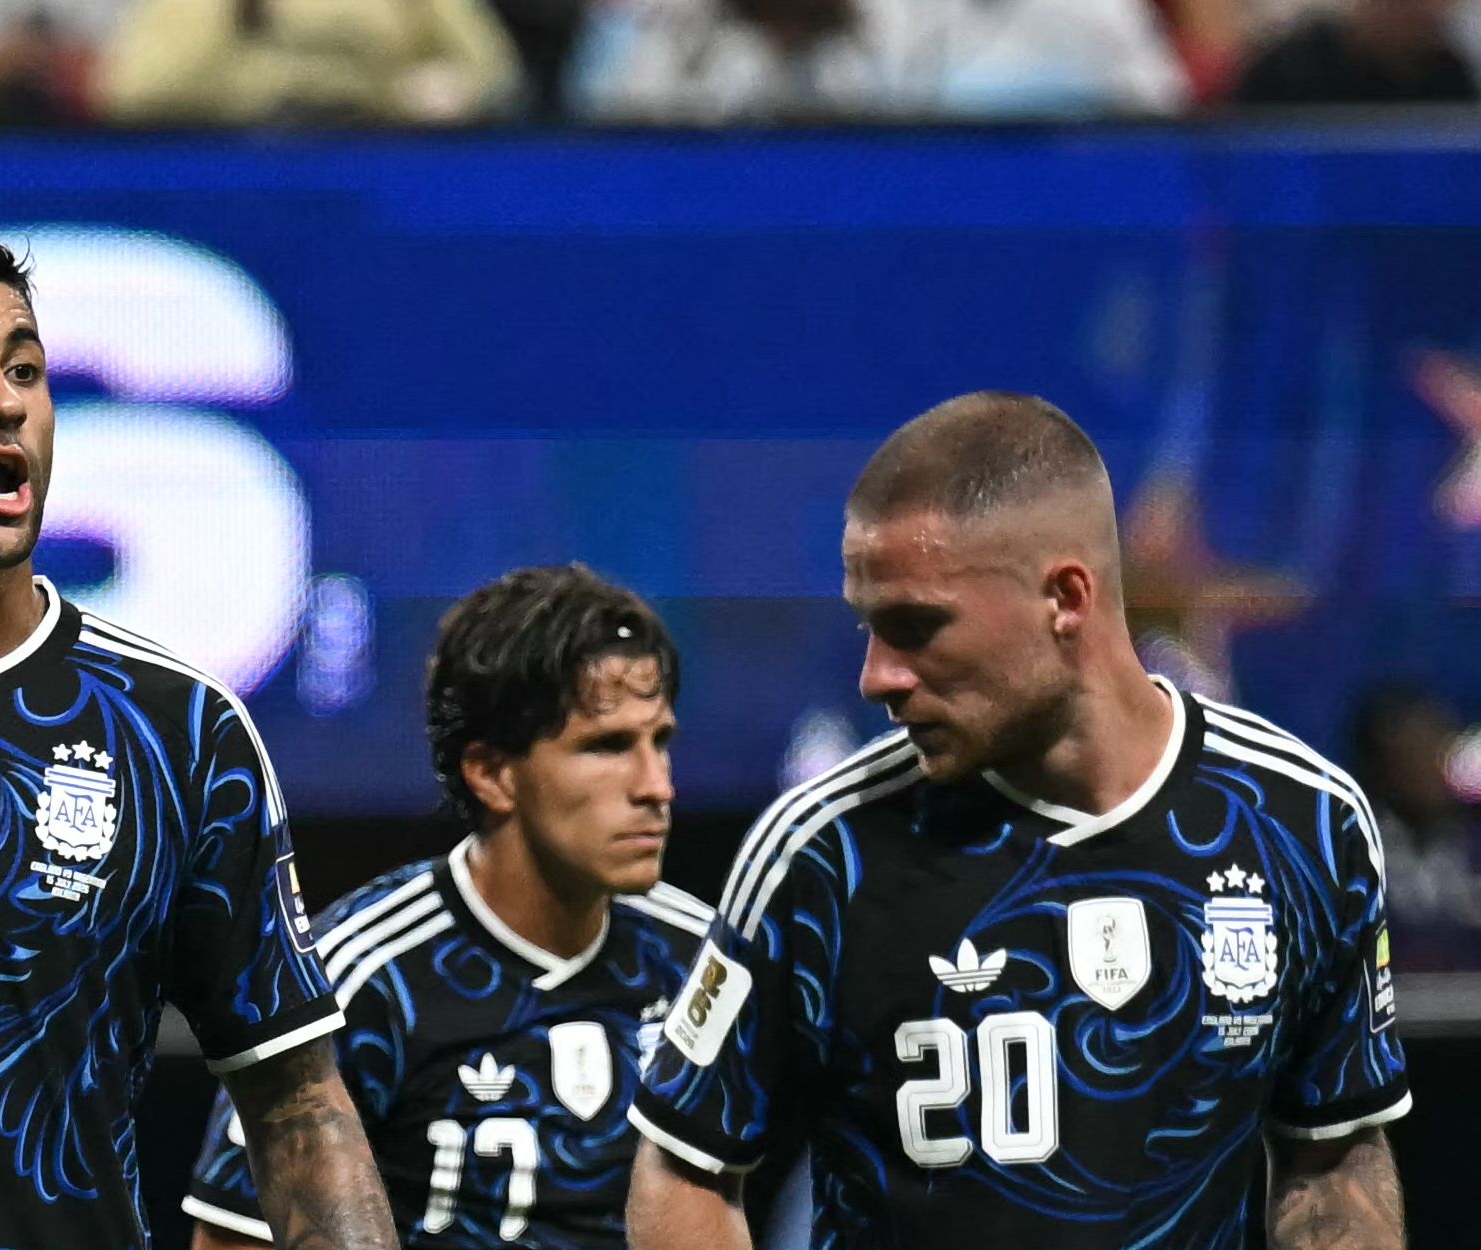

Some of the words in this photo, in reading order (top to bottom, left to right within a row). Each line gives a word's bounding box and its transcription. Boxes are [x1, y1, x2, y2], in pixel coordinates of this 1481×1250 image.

[55, 790, 98, 833] AFA
[1219, 926, 1261, 971] AFA
[1095, 967, 1129, 981] FIFA
[894, 1011, 1059, 1168] 20
[424, 1117, 540, 1241] 17
